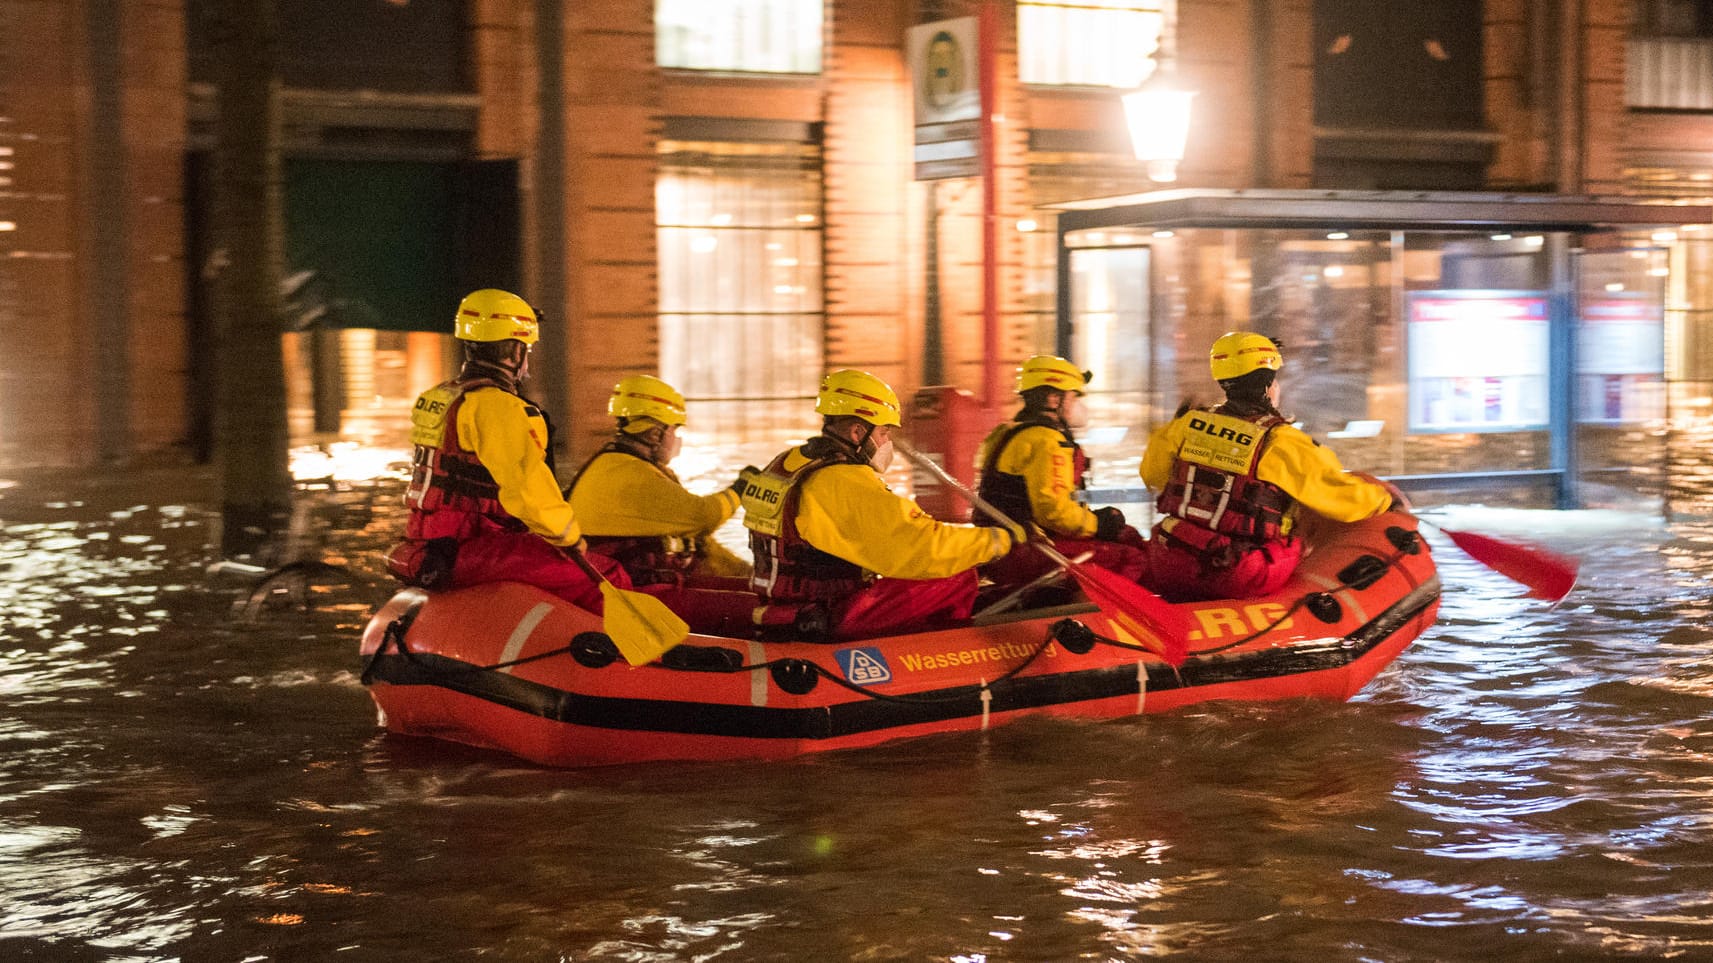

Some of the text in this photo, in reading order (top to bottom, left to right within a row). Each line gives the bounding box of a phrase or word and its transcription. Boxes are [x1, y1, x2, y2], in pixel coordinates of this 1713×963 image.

[1189, 418, 1253, 446] DLRG
[1215, 454, 1246, 467] RETTUNG
[746, 484, 779, 505] DLRG
[899, 641, 1057, 673] Wasserrettung
